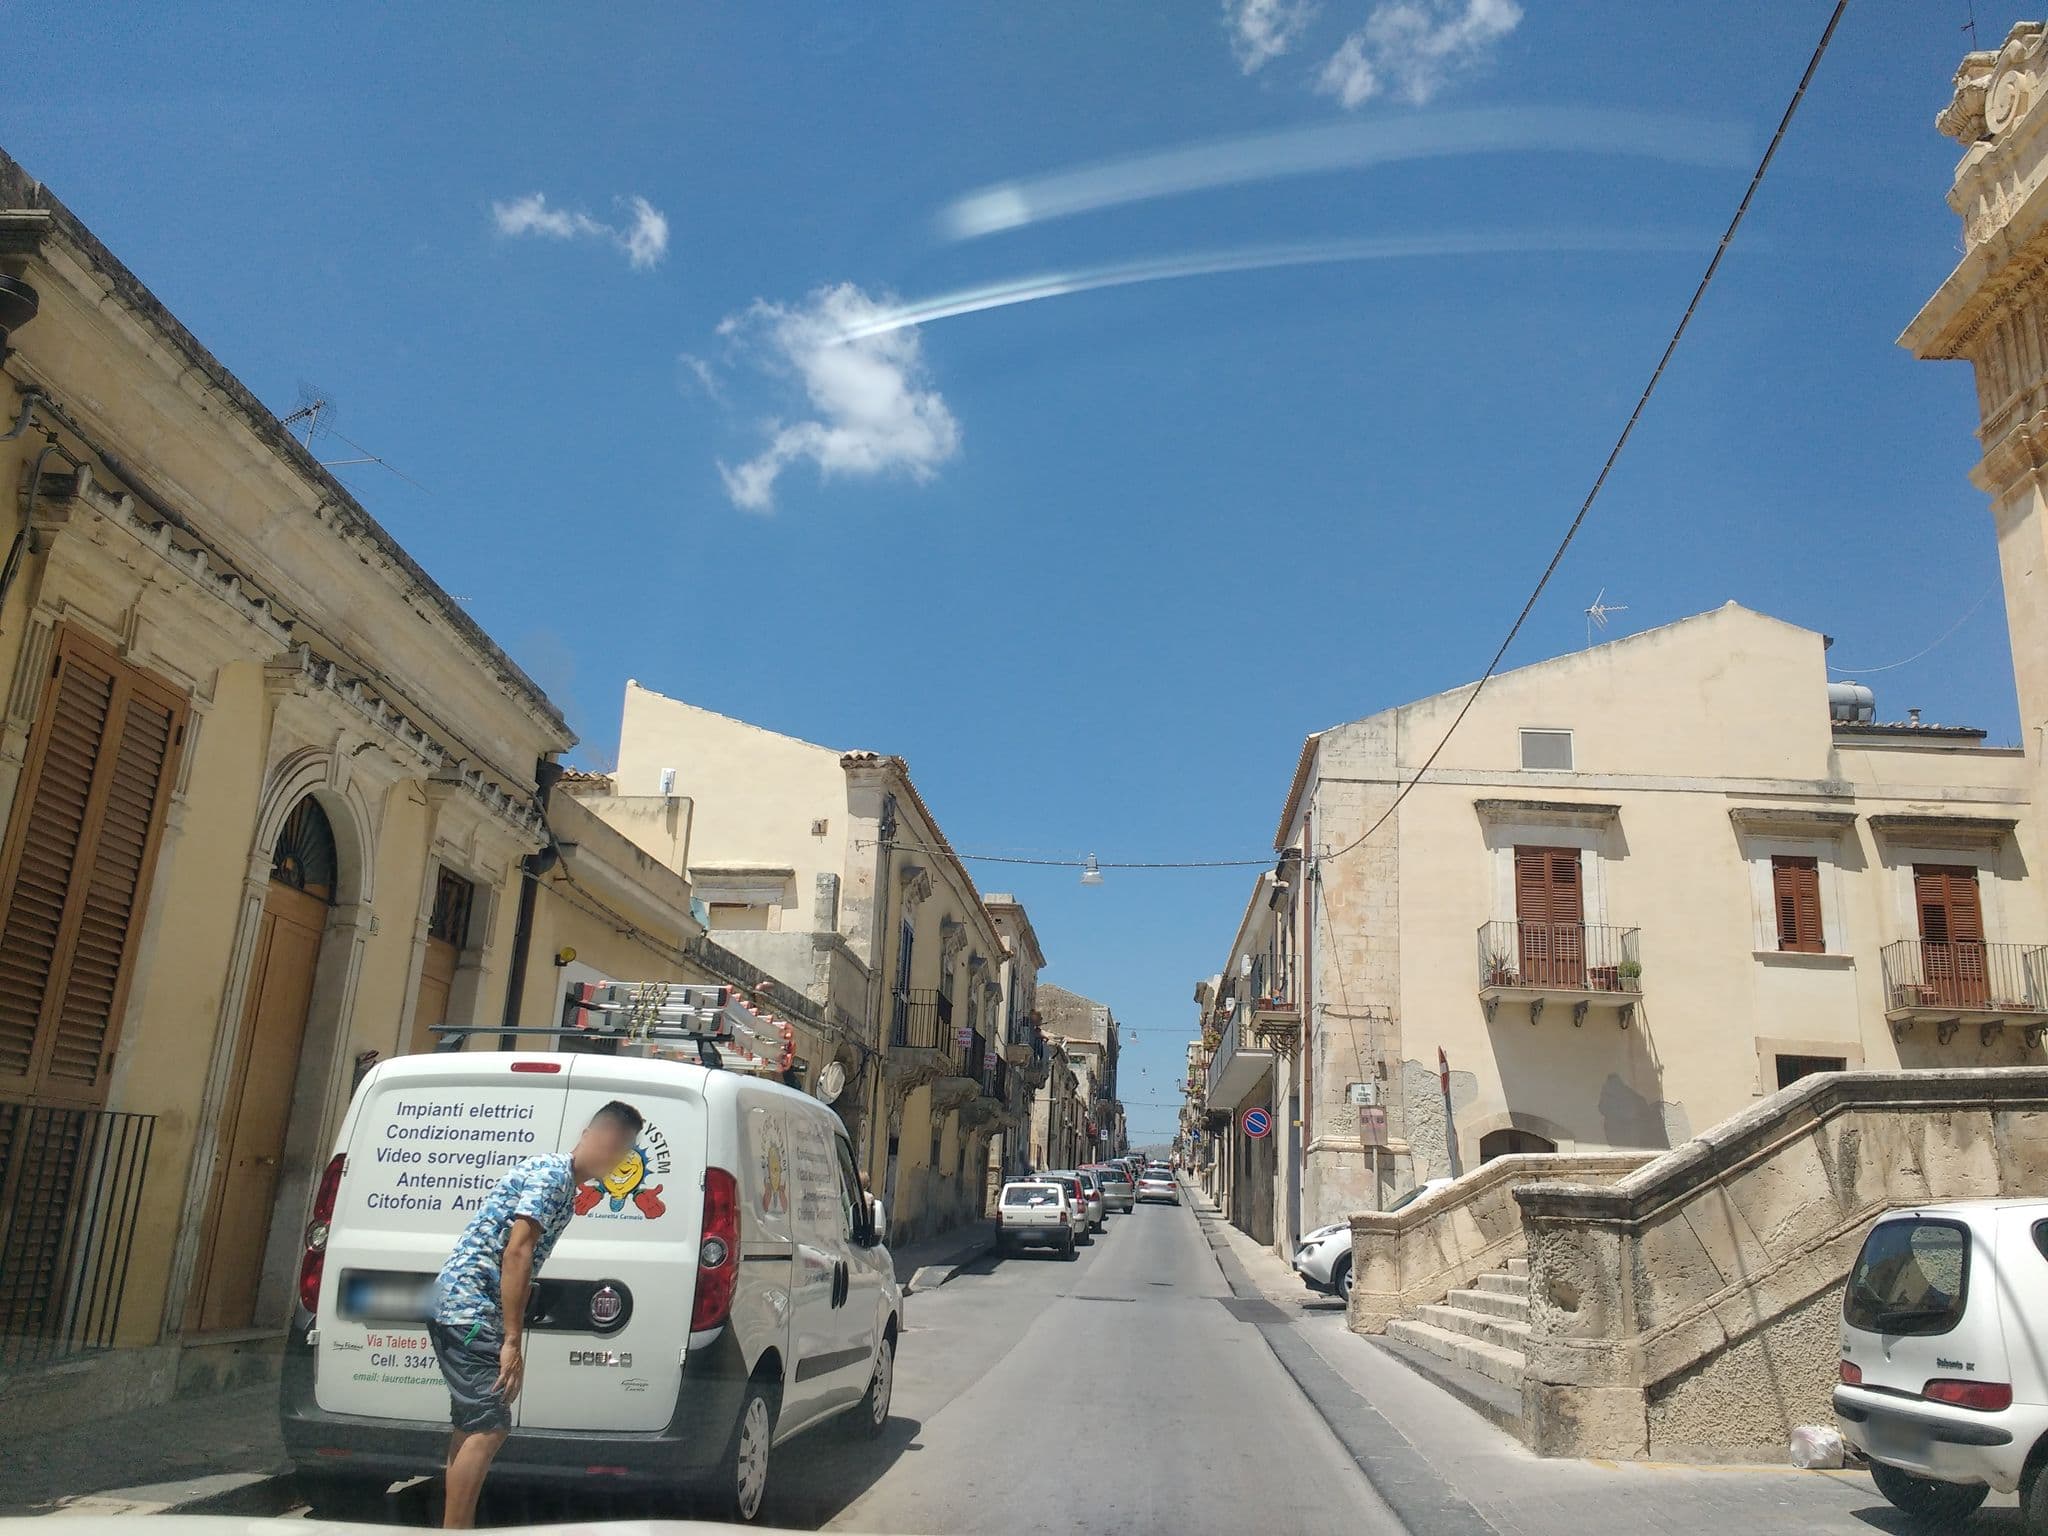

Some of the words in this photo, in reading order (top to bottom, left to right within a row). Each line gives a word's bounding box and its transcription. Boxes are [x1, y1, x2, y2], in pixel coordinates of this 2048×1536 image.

[396, 1101, 465, 1119] Impianti
[469, 1103, 534, 1119] elettrici
[386, 1124, 536, 1143] Condizionamento
[644, 1121, 671, 1174] YSTEM
[376, 1147, 422, 1163] Video
[427, 1150, 530, 1168] sorveglianz
[367, 1193, 442, 1211] Citofonia
[451, 1195, 488, 1211] Ant
[597, 1297, 618, 1317] FIAT
[366, 1334, 383, 1348] Via
[386, 1335, 417, 1349] Talete
[420, 1337, 428, 1350] 9
[371, 1353, 399, 1368] Cell.
[353, 1372, 379, 1383] email:
